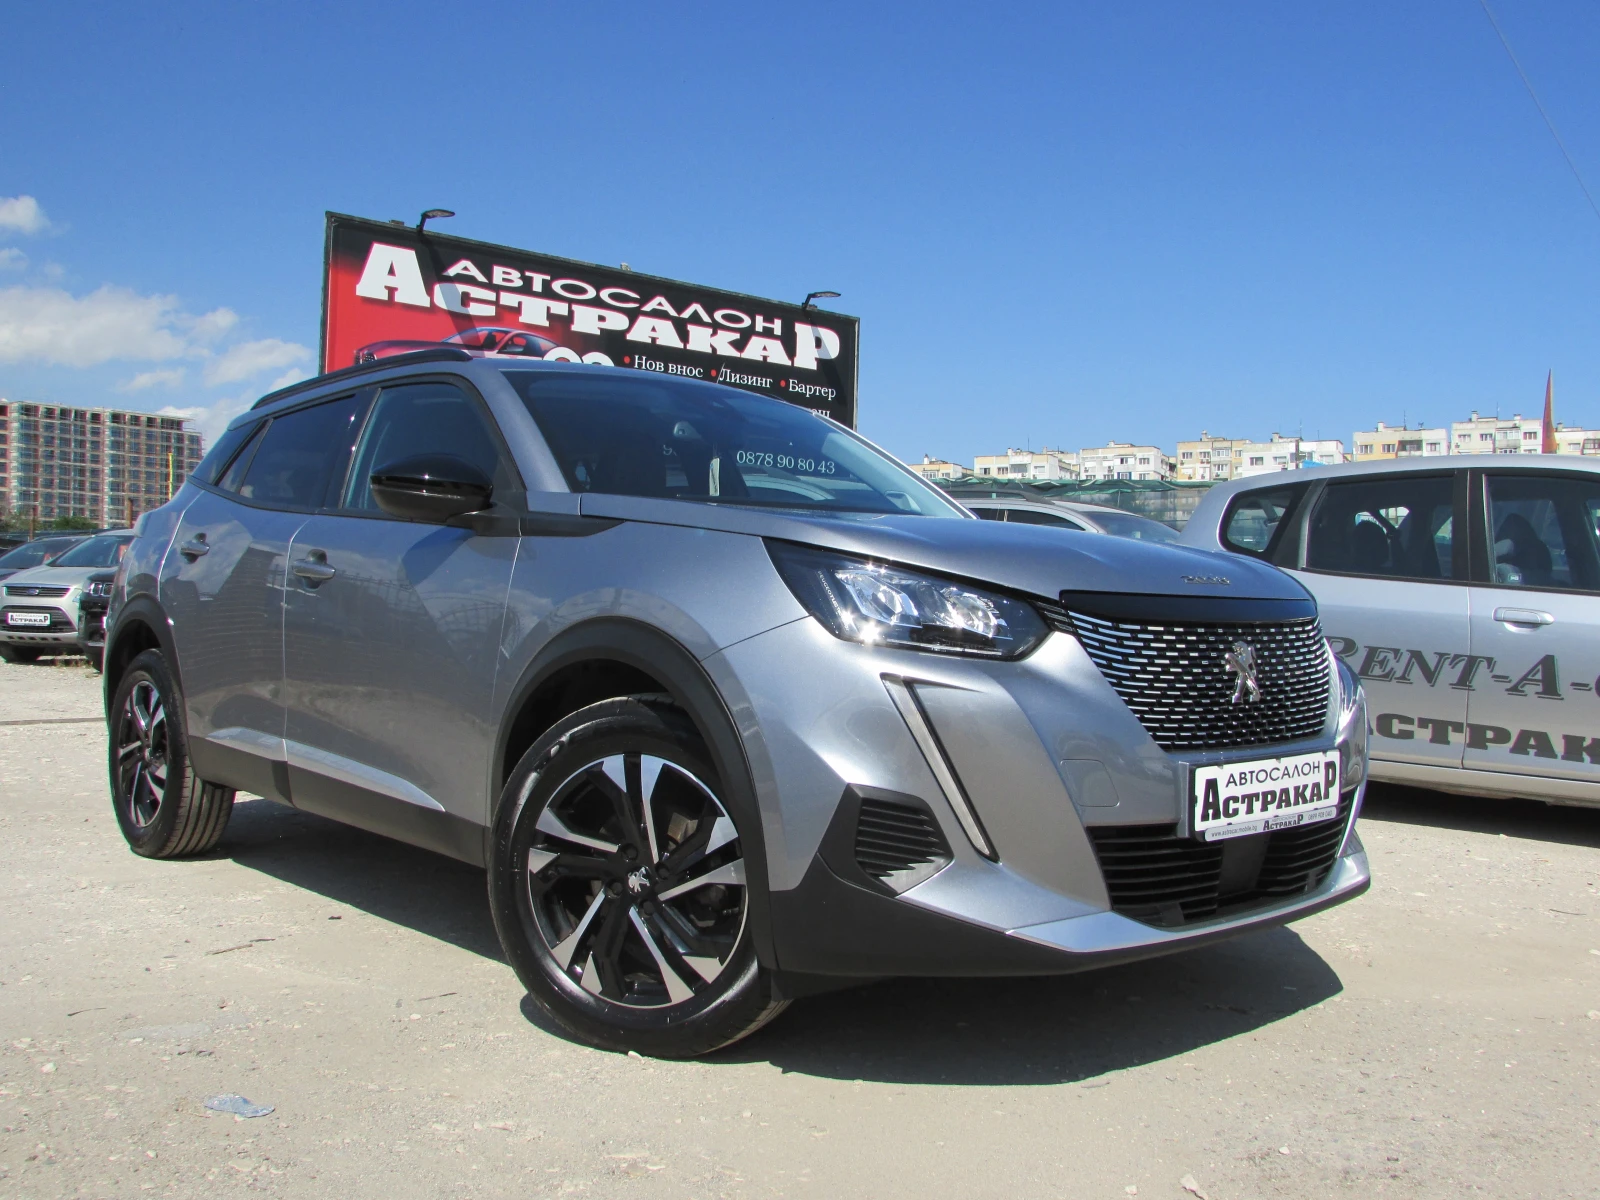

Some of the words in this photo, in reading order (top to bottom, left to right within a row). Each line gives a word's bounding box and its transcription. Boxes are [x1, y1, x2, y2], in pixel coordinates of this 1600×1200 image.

[441, 259, 783, 336] АВТОСАЛОН
[634, 355, 665, 373] Нов
[668, 363, 704, 378] внос
[719, 367, 774, 389] Лизинг
[789, 378, 837, 401] Бартер
[736, 450, 774, 467] 0878
[777, 454, 795, 469] 90
[797, 458, 815, 472] 80
[817, 460, 836, 475] 43
[1324, 635, 1600, 700] RENT-A-
[1368, 712, 1600, 766] СТРАК
[1225, 760, 1321, 788] АВТОСАЛОН
